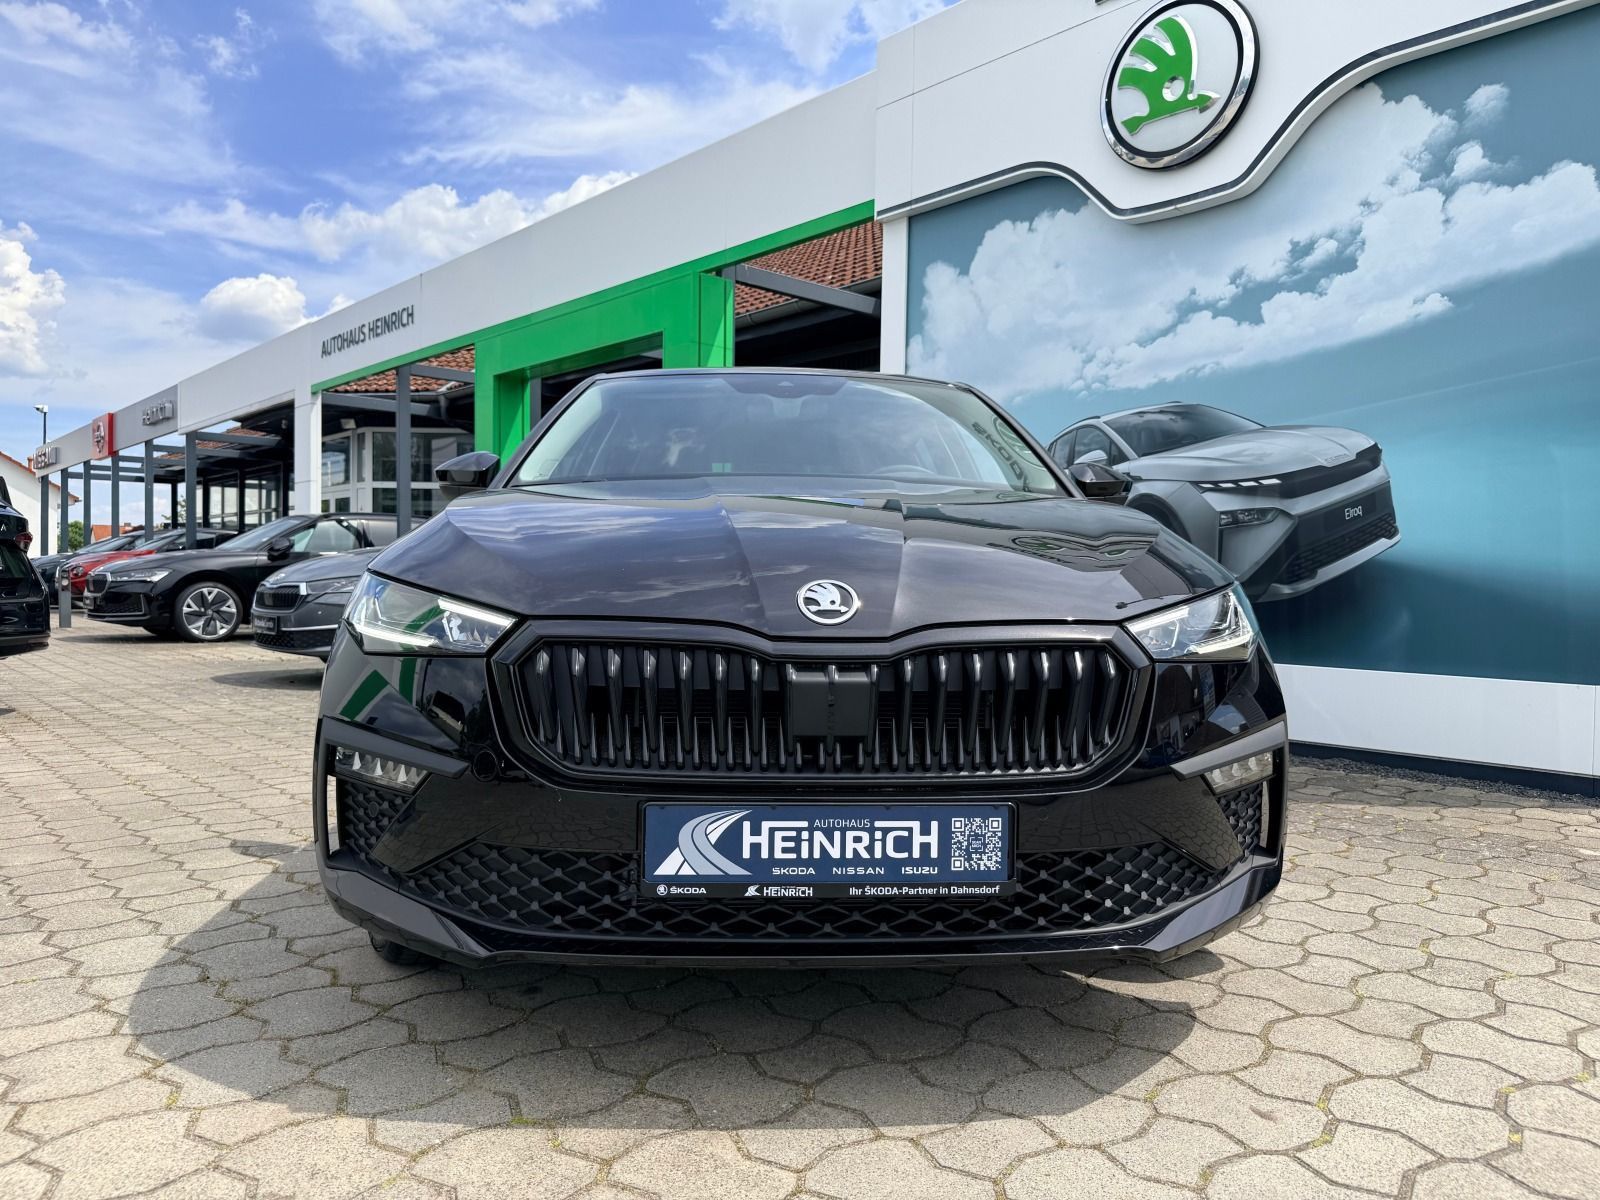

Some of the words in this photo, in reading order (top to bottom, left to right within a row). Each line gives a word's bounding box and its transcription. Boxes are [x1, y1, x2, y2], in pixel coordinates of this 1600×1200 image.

[321, 324, 366, 359] AUTOHAUS
[368, 304, 414, 340] HEINRICH
[1344, 505, 1363, 520] Elroq
[813, 818, 871, 828] AUTOHAUS
[832, 866, 885, 875] NISSAN
[901, 866, 938, 875] ISUZU
[669, 886, 707, 895] ŠKODA
[849, 887, 862, 896] Ihr
[865, 885, 937, 896] ŠKODA-Partner
[939, 886, 948, 895] in
[951, 885, 1000, 895] Dahnsdorf
